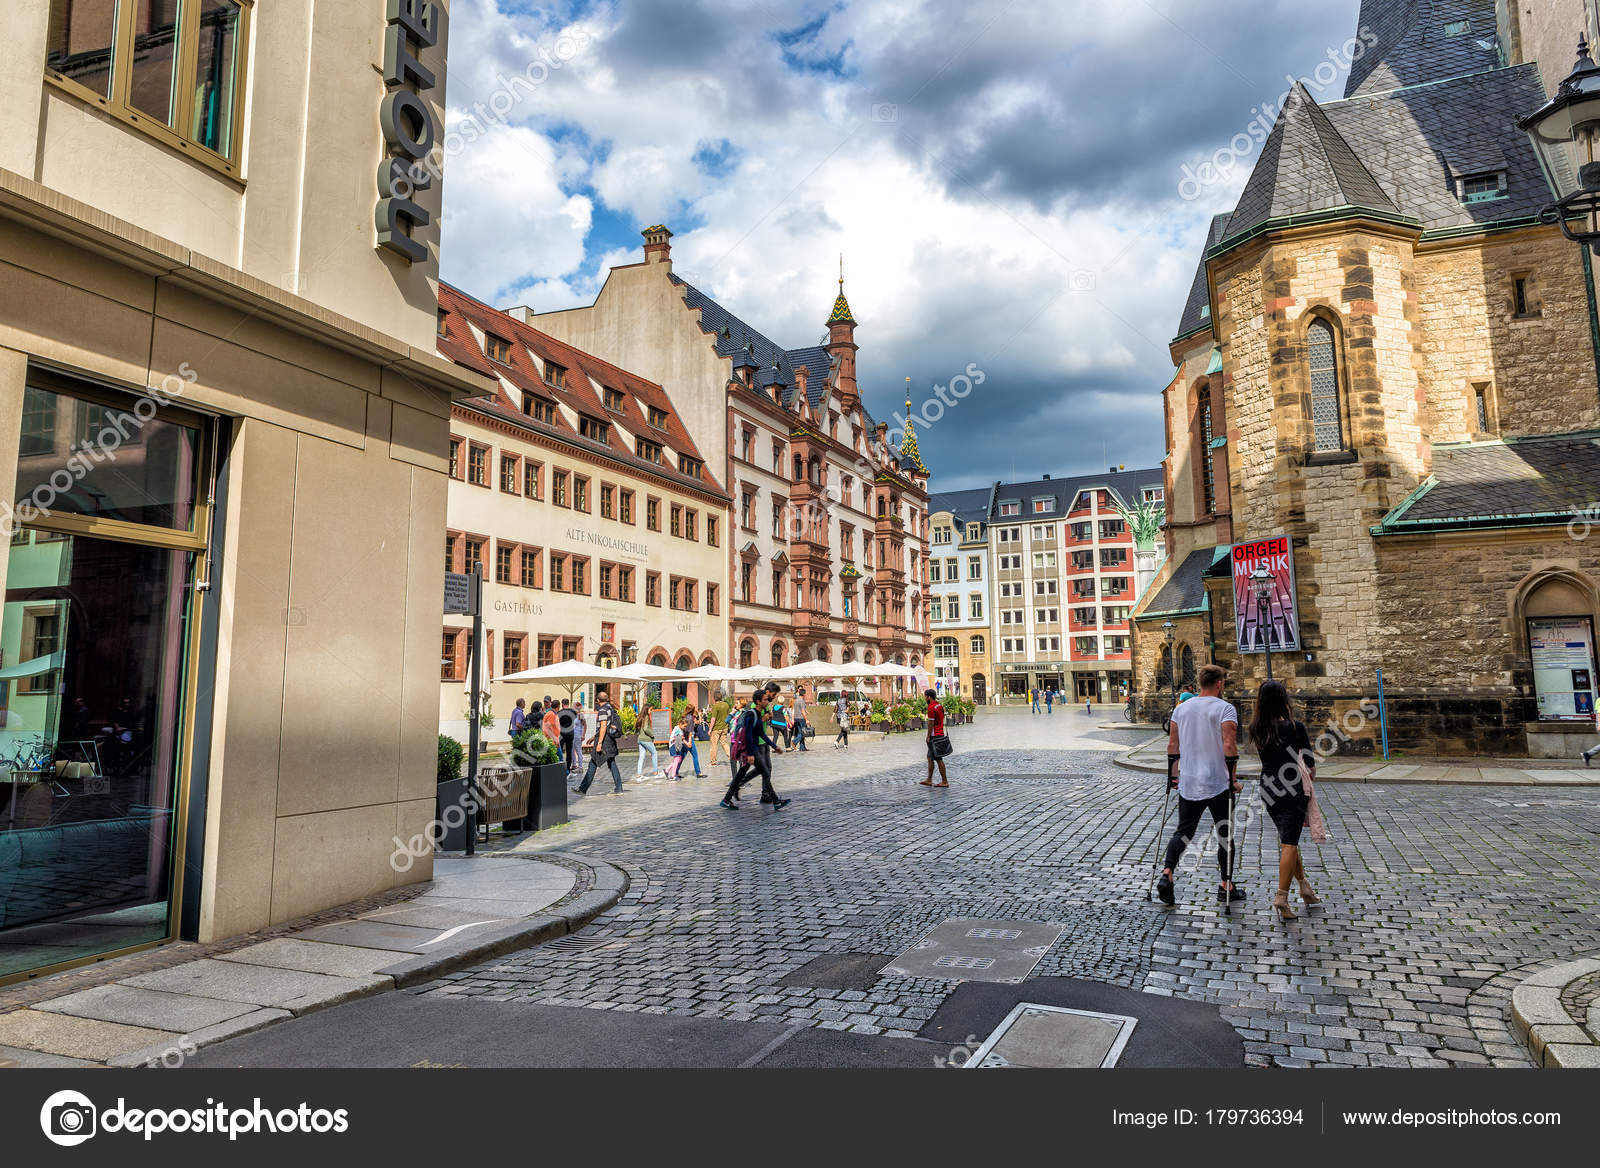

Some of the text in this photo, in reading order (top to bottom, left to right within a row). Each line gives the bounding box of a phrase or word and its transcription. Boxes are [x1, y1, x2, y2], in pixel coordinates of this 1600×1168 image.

[565, 528, 649, 556] ALTE NIKOLAISCHULE
[1234, 538, 1288, 561] ORGEL
[1234, 554, 1289, 577] MUSIK
[494, 600, 543, 616] GASTHAUS
